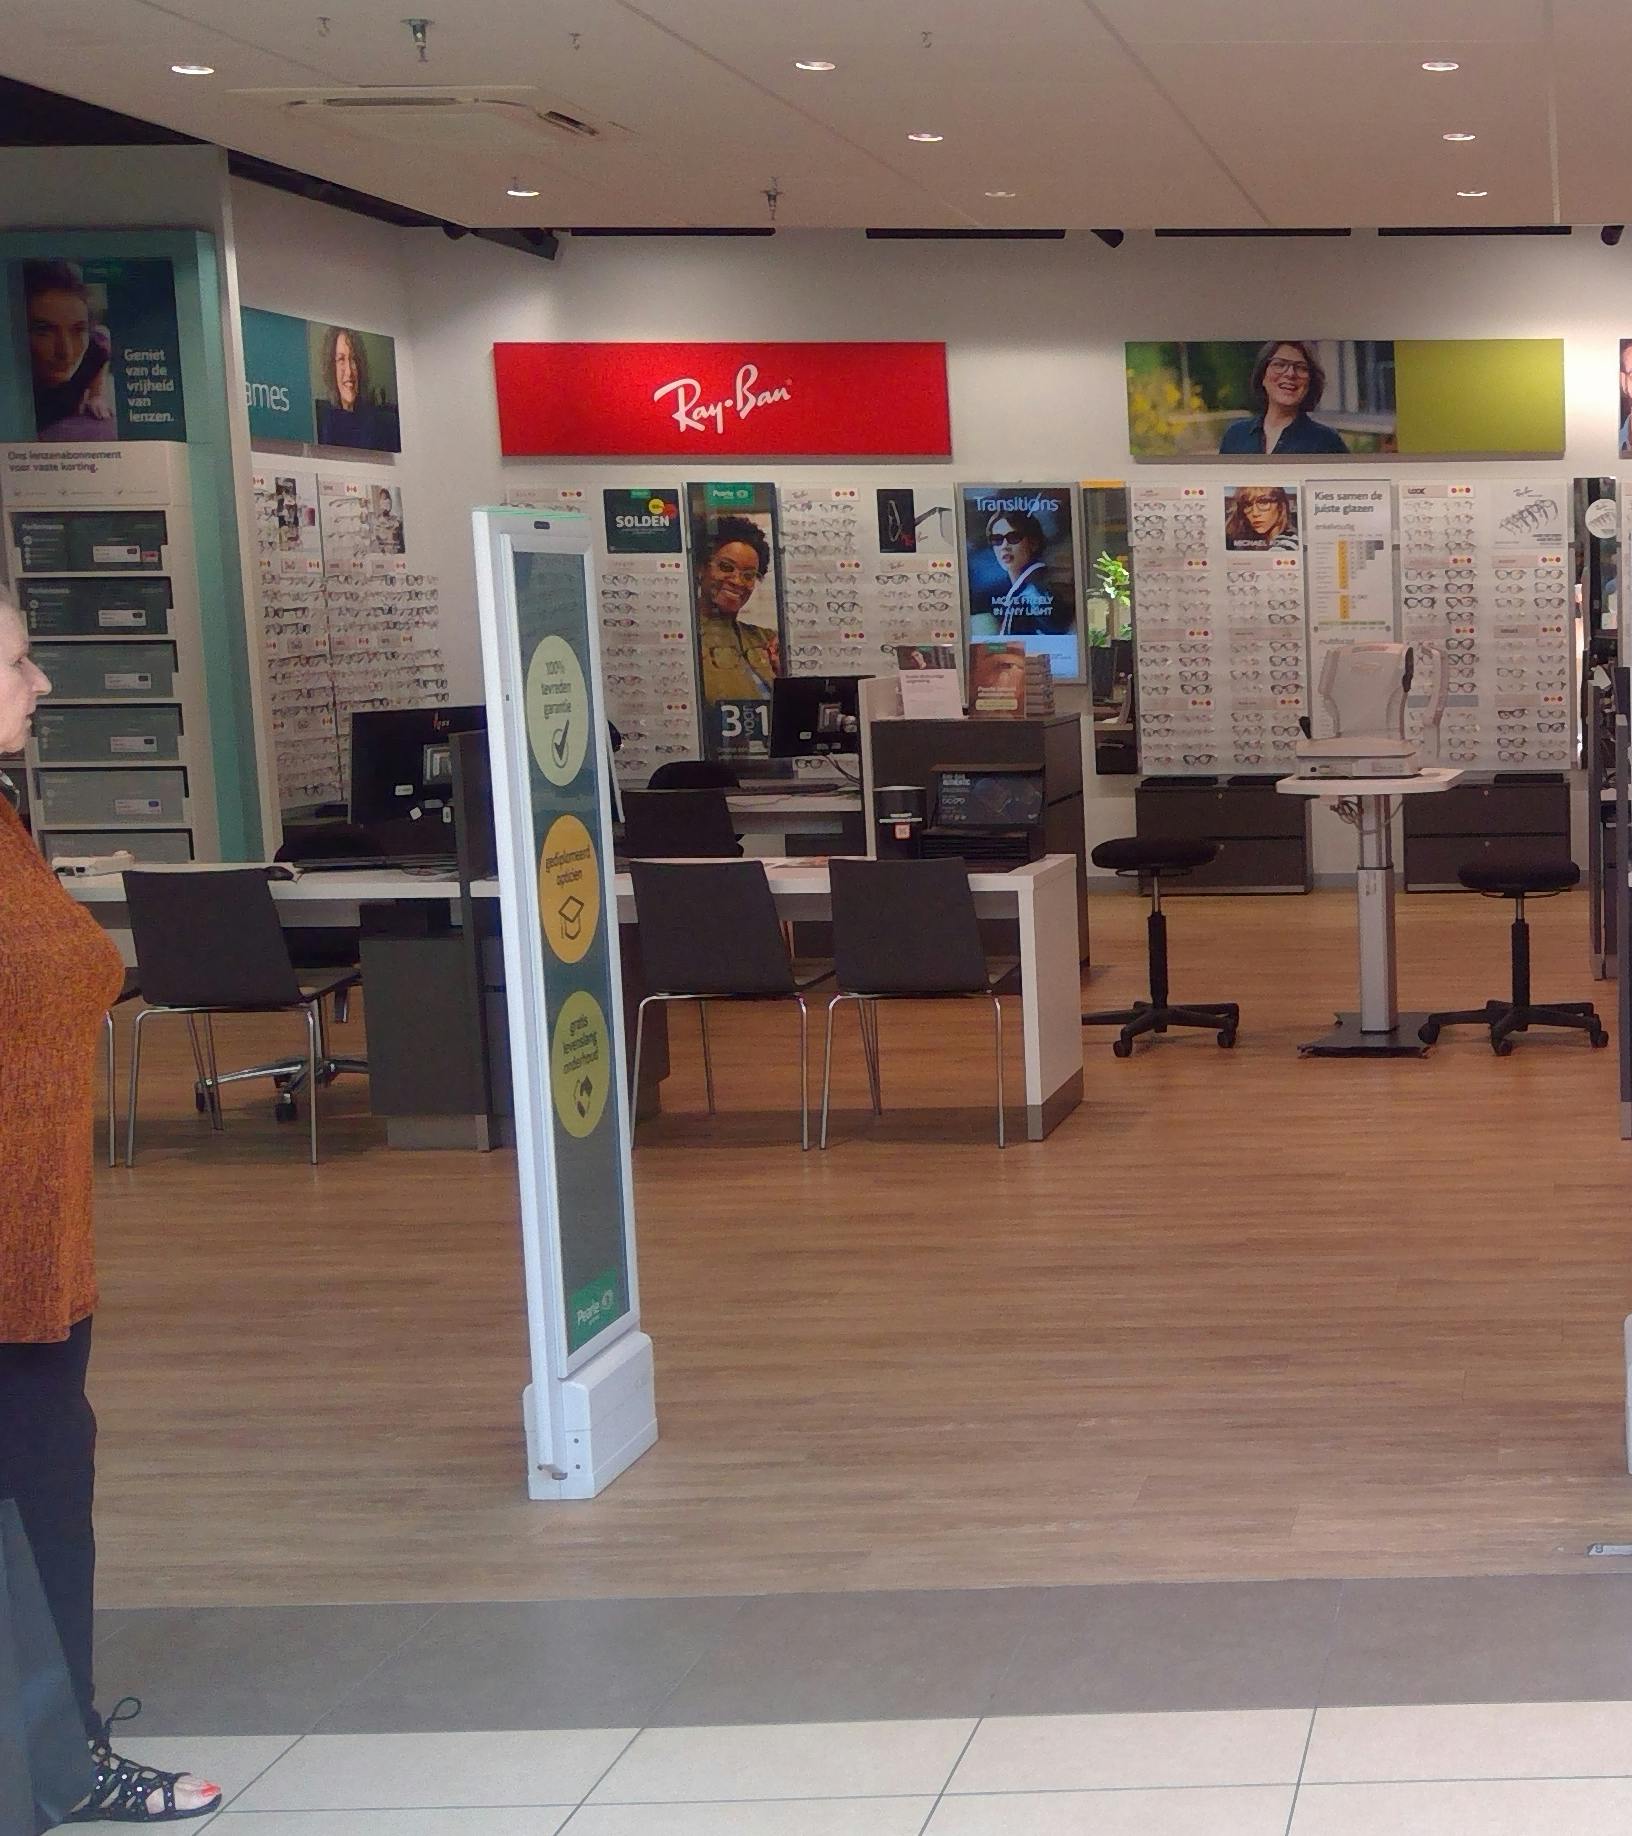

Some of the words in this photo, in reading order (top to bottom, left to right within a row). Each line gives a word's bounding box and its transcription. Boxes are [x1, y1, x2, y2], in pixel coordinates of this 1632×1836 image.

[124, 349, 165, 361] Geniet
[126, 367, 148, 376] van
[152, 365, 167, 376] de
[127, 380, 174, 394] vrijheid
[128, 397, 151, 406] van
[130, 411, 174, 422] lenzen.
[8, 451, 27, 460] Ons
[9, 464, 30, 472] voor
[34, 464, 58, 472] vaste
[61, 463, 98, 473] korting.
[1315, 491, 1334, 500] Kies
[1337, 492, 1368, 500] samen
[1371, 491, 1383, 500] de
[975, 493, 1059, 517] Transitions
[1314, 504, 1341, 515] juiste
[1343, 504, 1374, 515] glazen
[616, 515, 670, 528] SOLDEN
[545, 660, 566, 675] 100%
[541, 682, 572, 695] tevreden
[543, 699, 572, 719] garantie
[721, 705, 742, 737] 3
[743, 705, 755, 736] voor
[755, 705, 769, 736] 1
